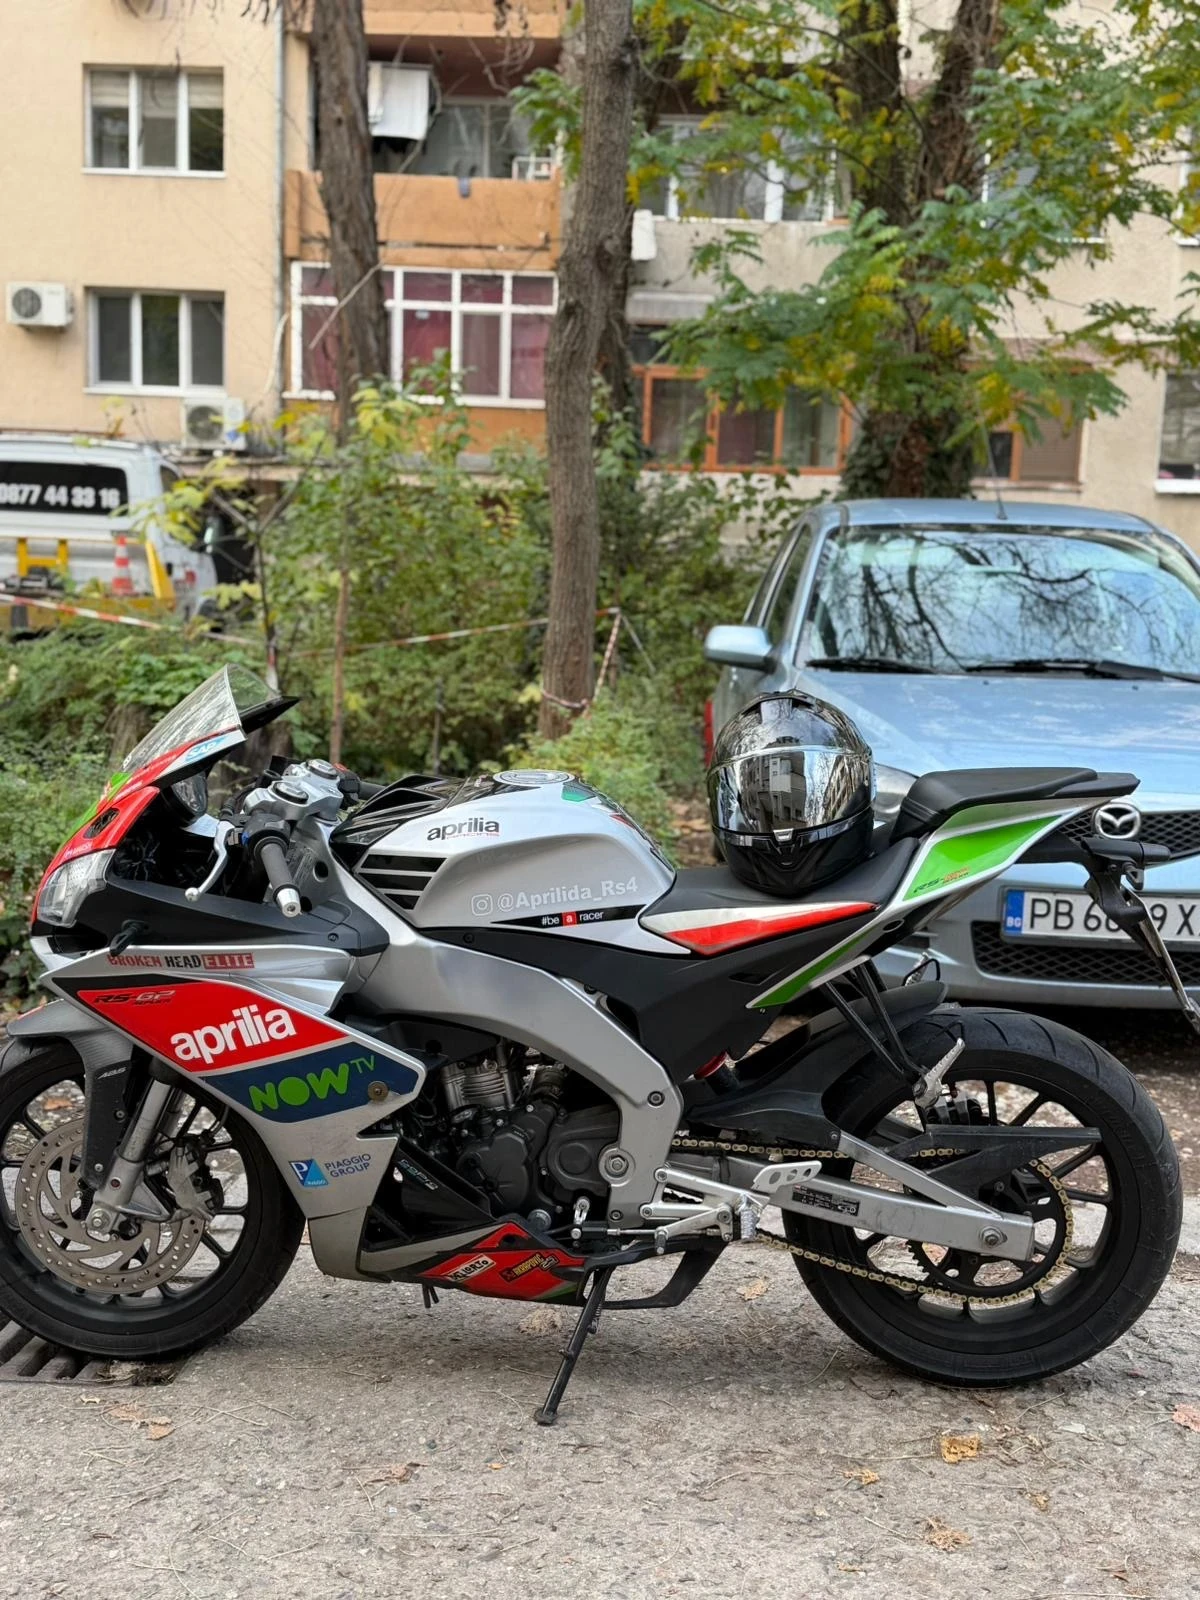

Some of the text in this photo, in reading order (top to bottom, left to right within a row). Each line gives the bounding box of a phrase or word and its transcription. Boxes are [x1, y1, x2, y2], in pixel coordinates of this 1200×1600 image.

[43, 485, 69, 506] 44
[427, 817, 500, 840] aprilia
[497, 877, 638, 912] @Aprilida_Rs4
[541, 914, 560, 926] #be
[579, 911, 605, 922] racer
[1006, 917, 1022, 928] BG
[1029, 898, 1074, 930] PB
[108, 953, 254, 969] BROKEN HEAD ELITE
[170, 1004, 297, 1064] aprilia
[249, 1055, 375, 1111] NOW TV
[324, 1153, 372, 1171] PIAGGIO
[330, 1162, 370, 1178] GROUP
